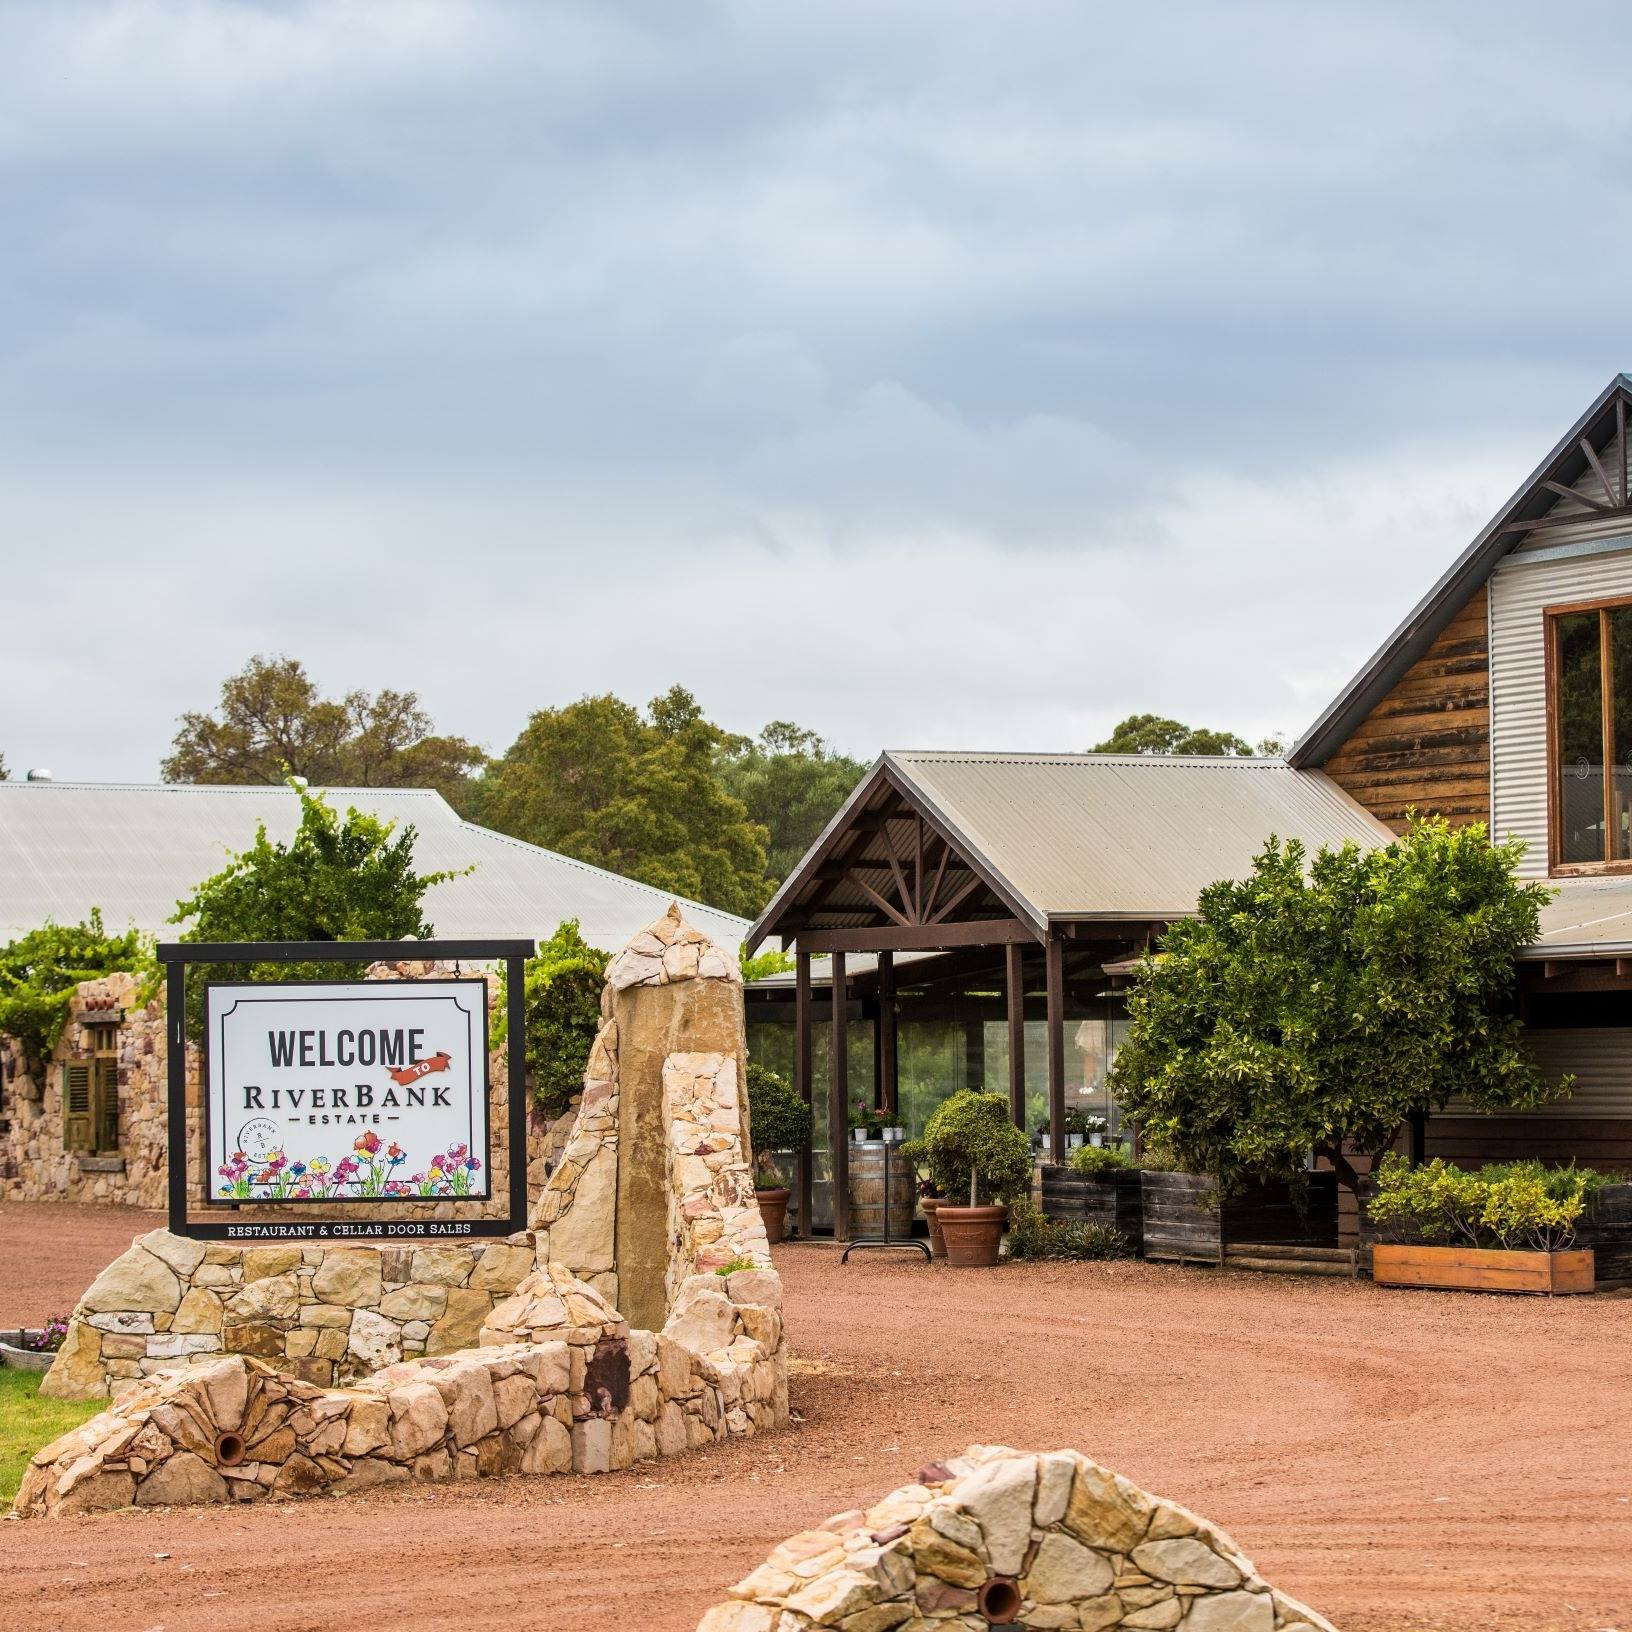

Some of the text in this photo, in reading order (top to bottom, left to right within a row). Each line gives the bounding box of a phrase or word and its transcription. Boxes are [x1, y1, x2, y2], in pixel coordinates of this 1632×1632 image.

[268, 1028, 425, 1067] WELCOME
[412, 1062, 431, 1076] TO
[308, 1113, 381, 1125] ESTATE
[227, 1224, 471, 1237] RESTAURANT & CELLAR DOOR SALES
